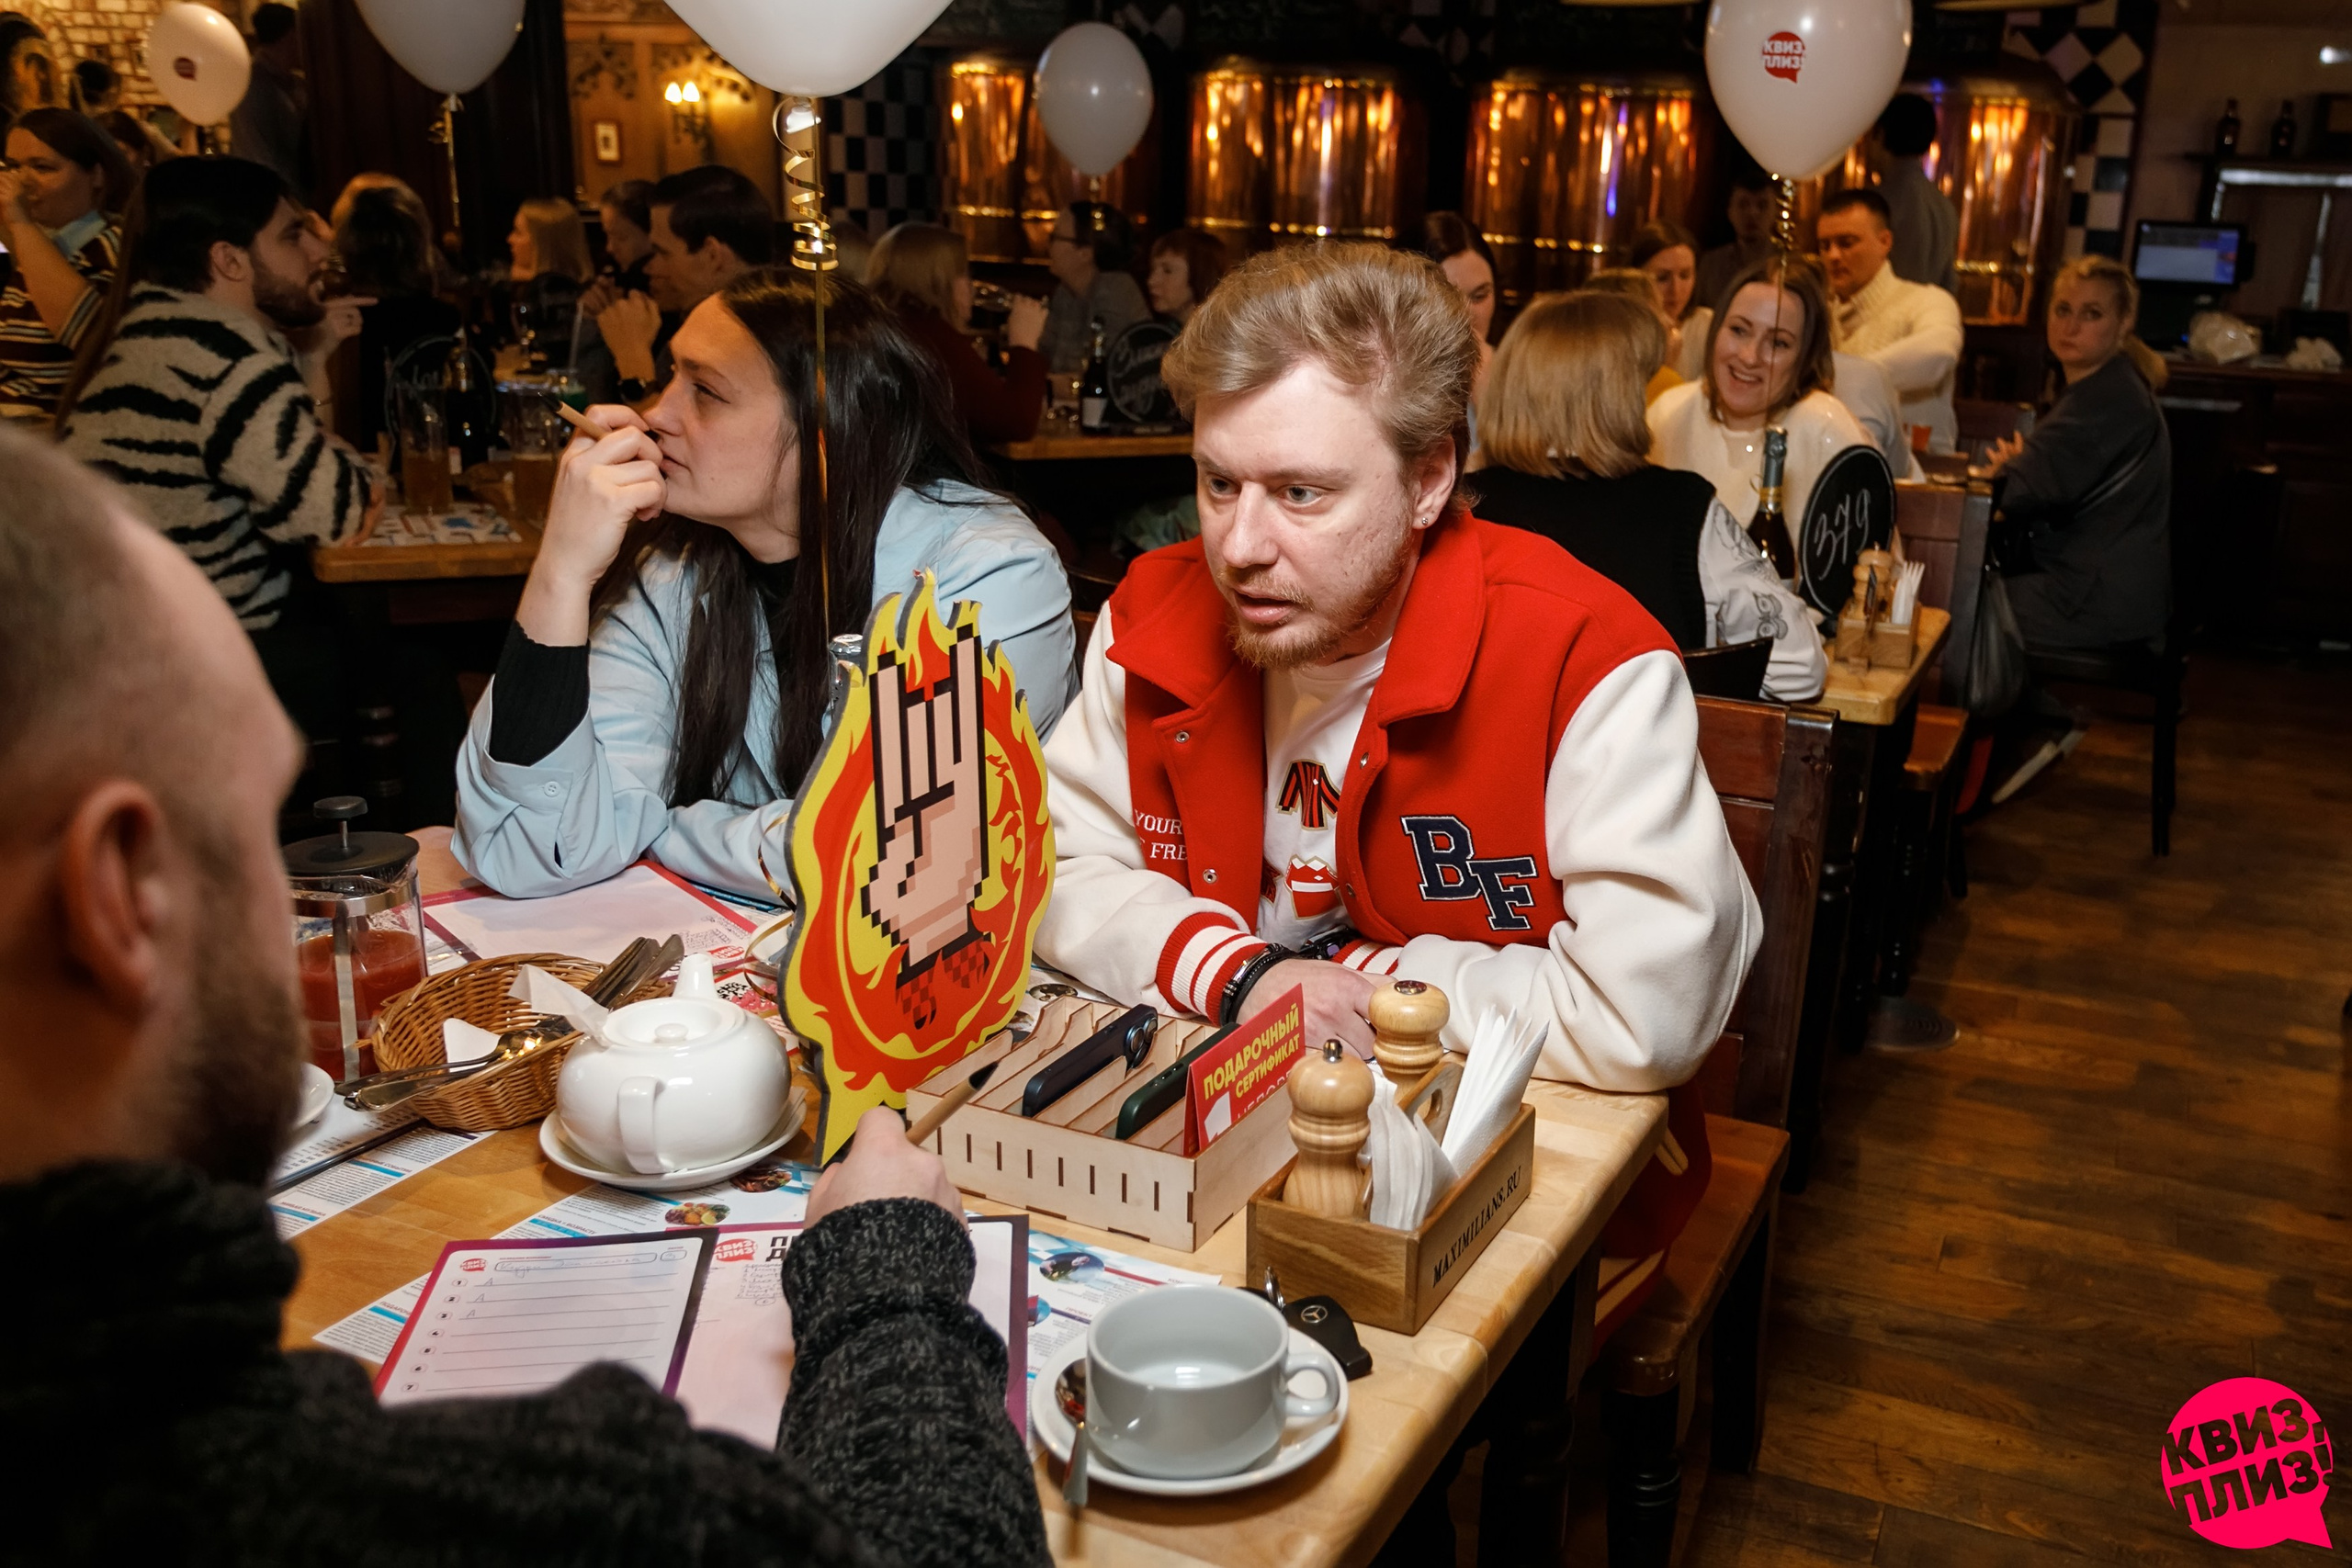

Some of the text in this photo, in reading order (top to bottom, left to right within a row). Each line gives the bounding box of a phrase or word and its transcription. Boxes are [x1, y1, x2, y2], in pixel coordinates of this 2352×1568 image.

[1814, 488, 1871, 581] 379
[1135, 808, 1182, 835] YOUR
[1204, 1002, 1299, 1100] ПОДАРОЧНЫЙ
[1235, 1033, 1300, 1099] СЕРТИФИКАТ
[1432, 1165, 1521, 1289] MAXIMILIANS.RU
